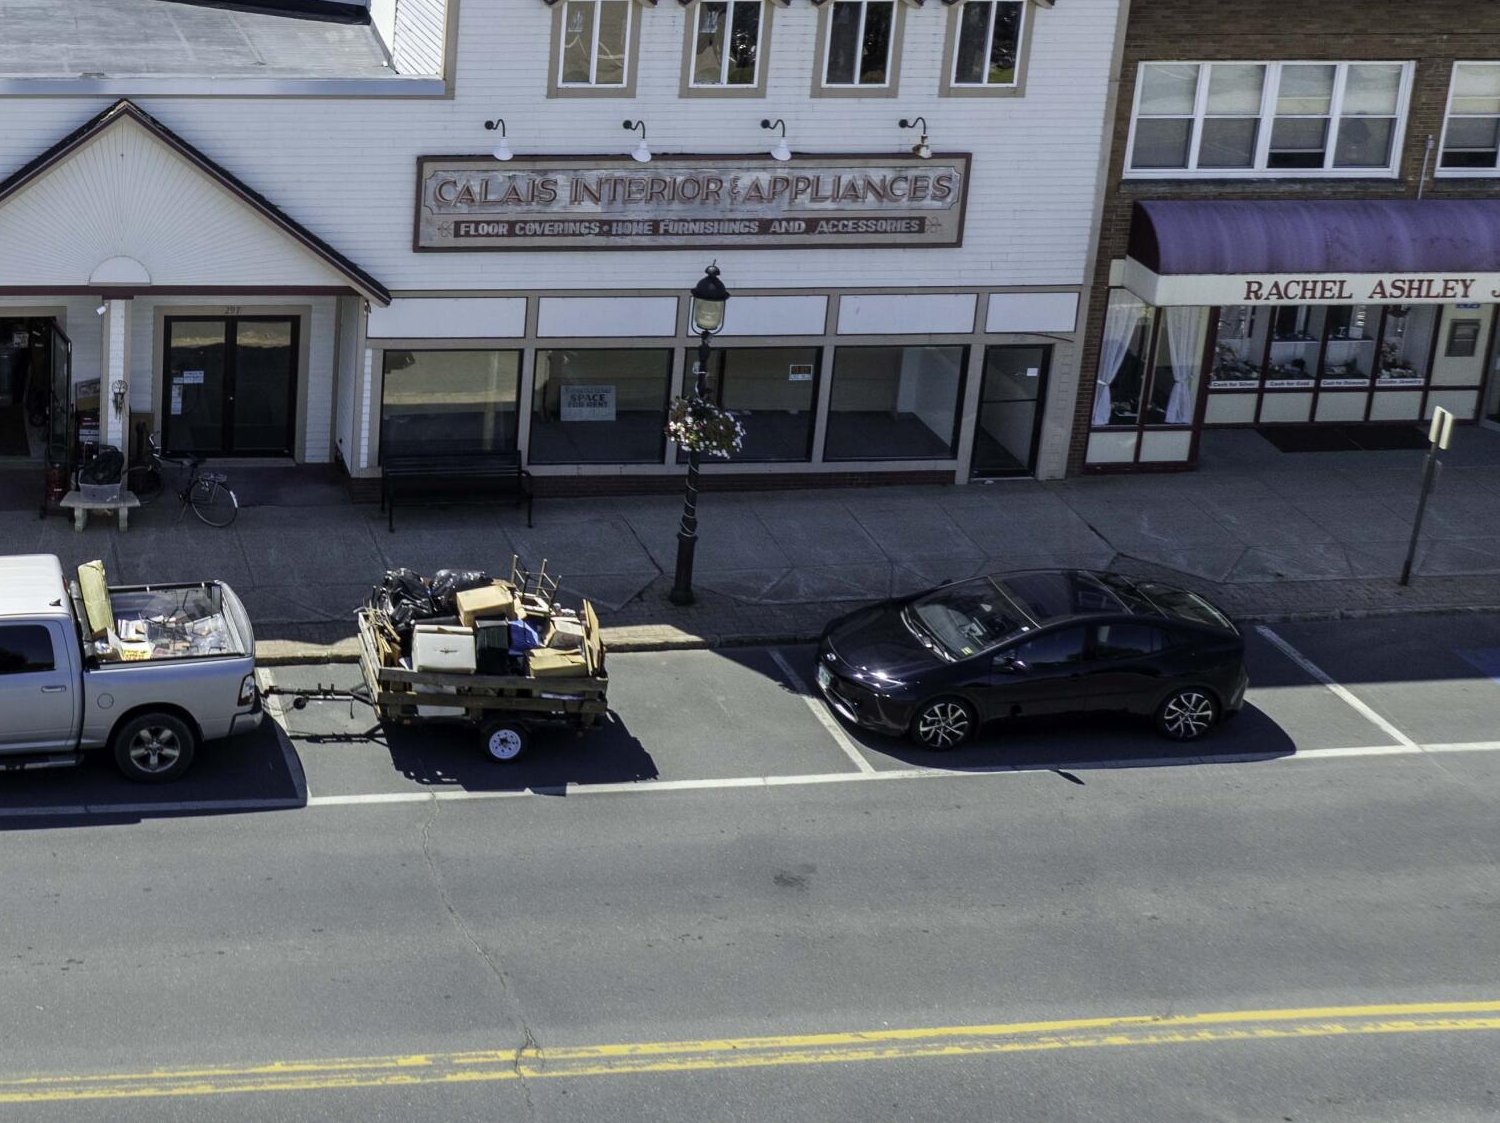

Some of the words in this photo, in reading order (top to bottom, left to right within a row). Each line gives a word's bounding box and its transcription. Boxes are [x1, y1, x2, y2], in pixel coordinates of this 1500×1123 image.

[434, 177, 558, 206] CALAIS
[571, 176, 723, 205] INTERIOR
[744, 174, 953, 204] APPLIANCES
[459, 223, 509, 236] FLOOR
[514, 221, 601, 236] COVERINGS
[611, 221, 653, 235] HOME
[658, 219, 760, 235] FURNISHINGS
[768, 220, 805, 233] AND
[816, 219, 919, 234] ACCESSORIES
[1243, 279, 1353, 301] RACHEL
[1368, 278, 1476, 299] ASHLEY
[570, 393, 605, 401] SPACE
